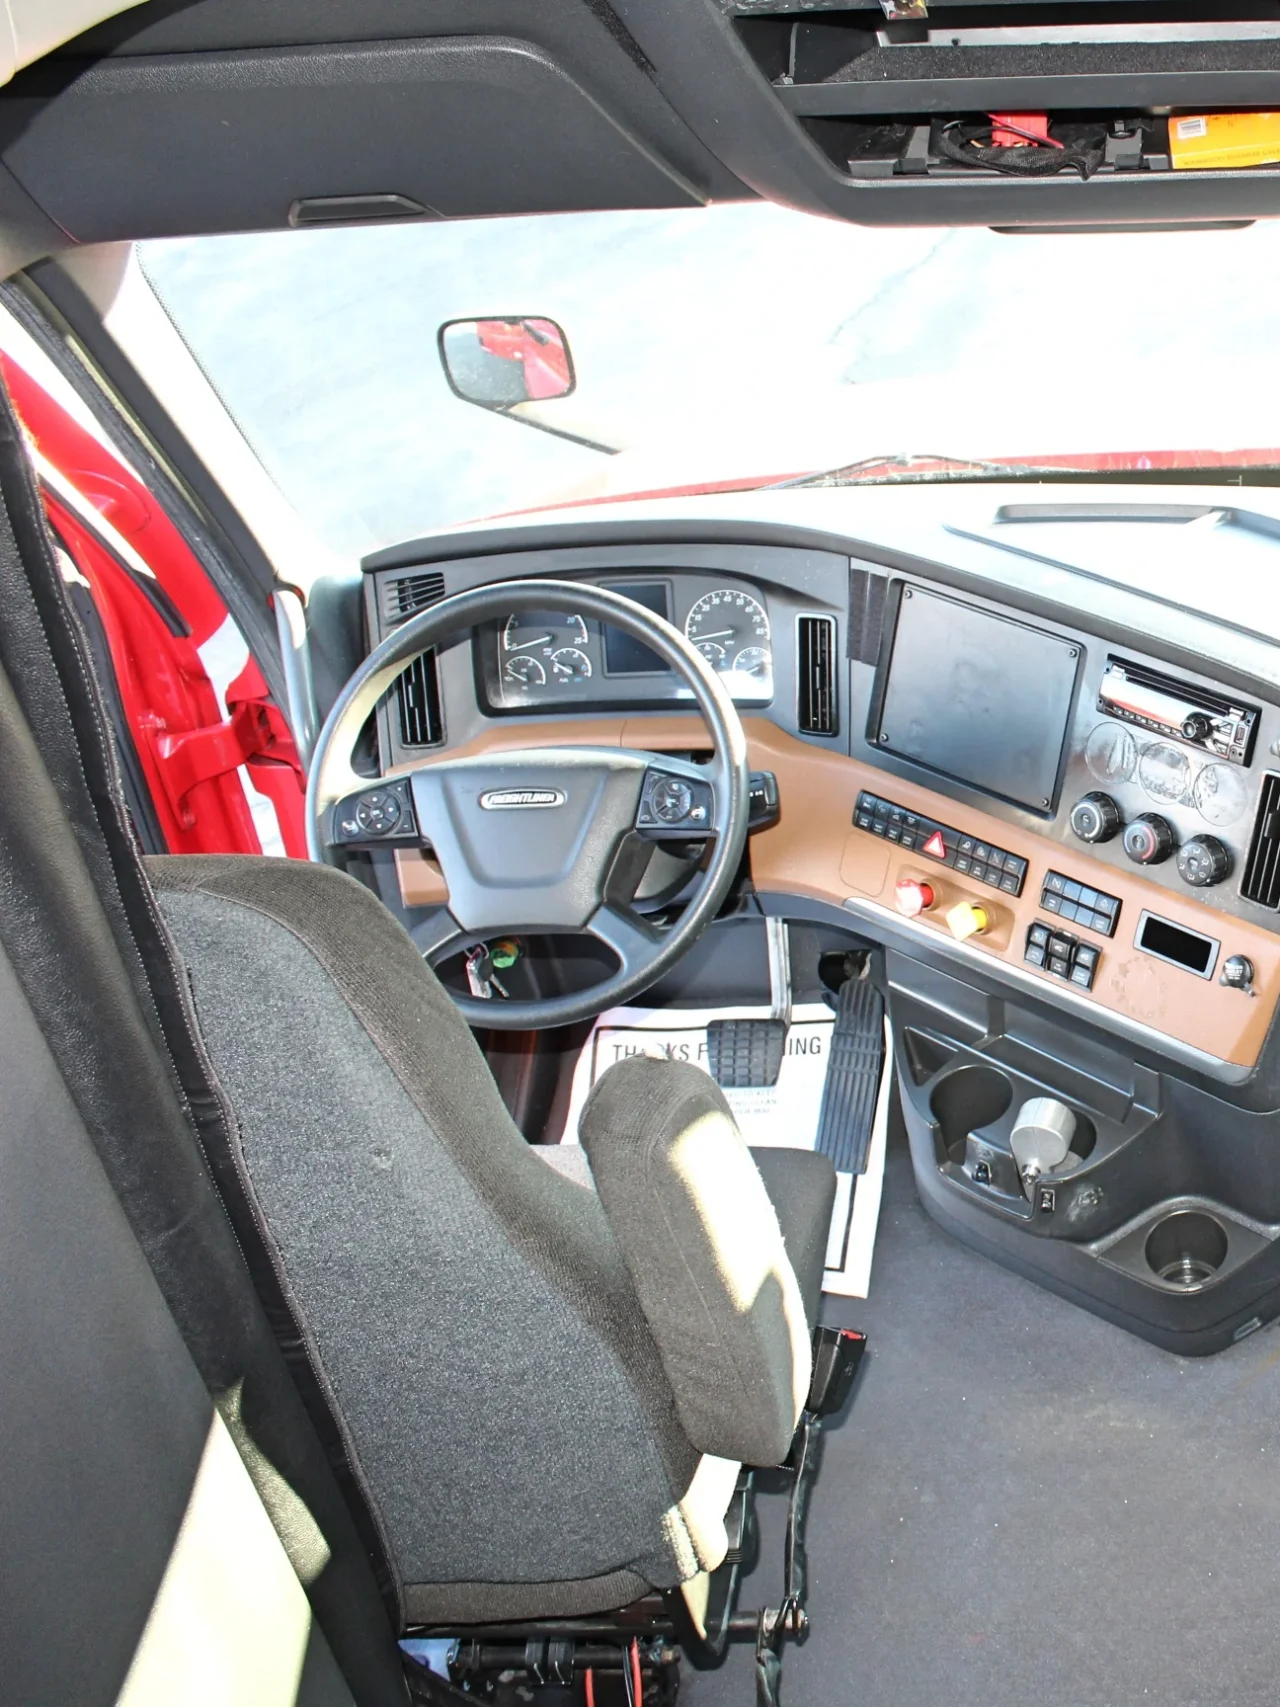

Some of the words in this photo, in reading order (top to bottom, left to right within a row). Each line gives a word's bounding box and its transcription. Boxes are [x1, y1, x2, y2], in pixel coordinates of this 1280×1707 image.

[722, 595, 733, 603] 45
[735, 598, 745, 606] 55
[701, 604, 711, 612] 25
[566, 616, 576, 624] 20
[751, 615, 761, 623] 75
[573, 636, 583, 645] 25
[489, 793, 555, 804] FREIGHTLINER
